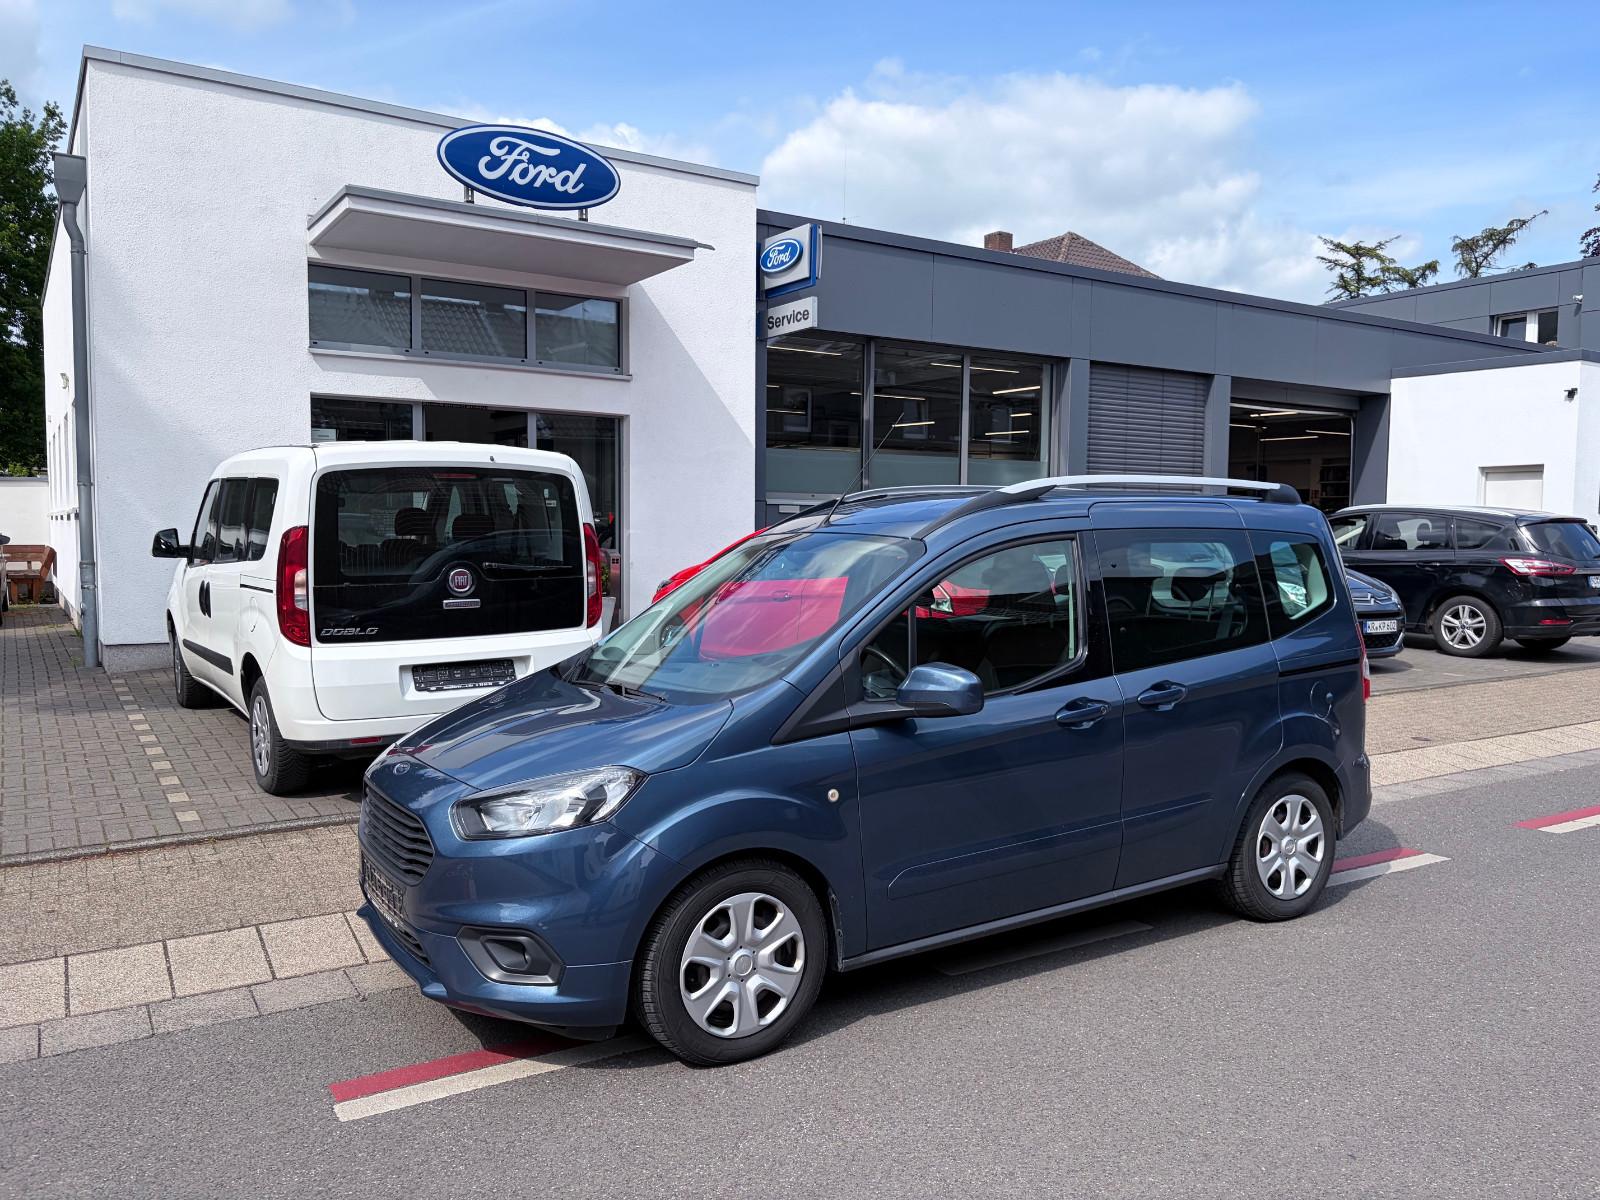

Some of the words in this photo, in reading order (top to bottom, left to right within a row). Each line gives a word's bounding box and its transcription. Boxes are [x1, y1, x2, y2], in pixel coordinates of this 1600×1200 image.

[478, 136, 587, 194] Ford
[767, 244, 792, 268] Ford
[767, 308, 810, 330] Service
[454, 575, 468, 586] FIAT
